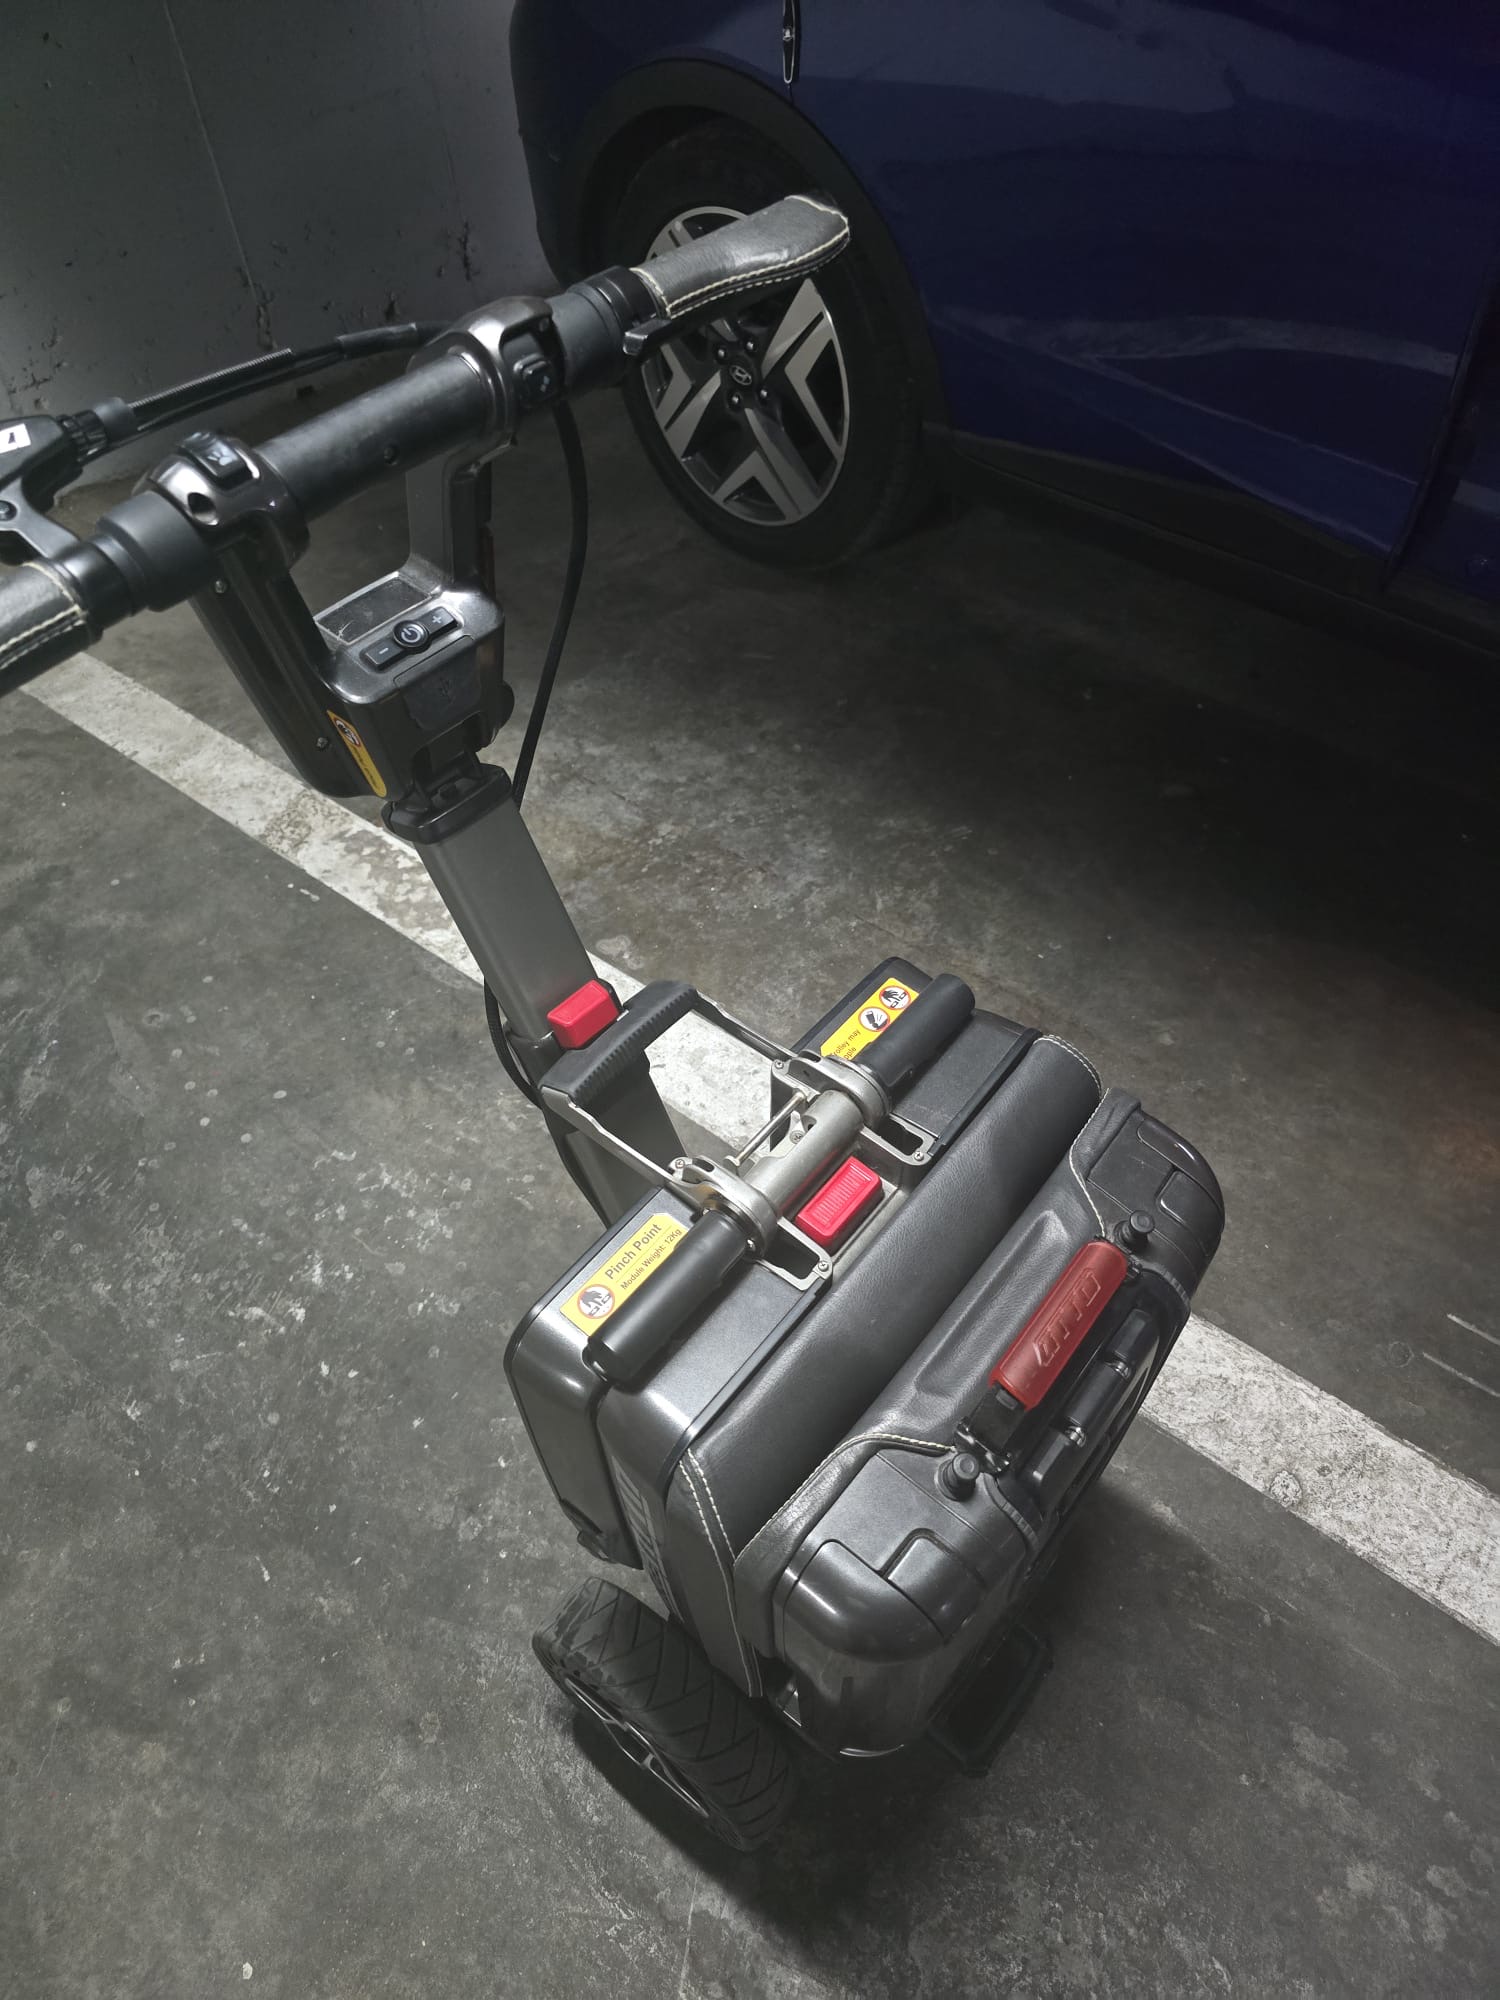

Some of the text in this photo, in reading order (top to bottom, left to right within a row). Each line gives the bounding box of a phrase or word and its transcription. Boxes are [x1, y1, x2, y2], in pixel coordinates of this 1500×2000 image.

[848, 1029, 861, 1041] may
[605, 1223, 662, 1280] Pinch Point
[620, 1228, 683, 1290] Module Weight: 12Kg
